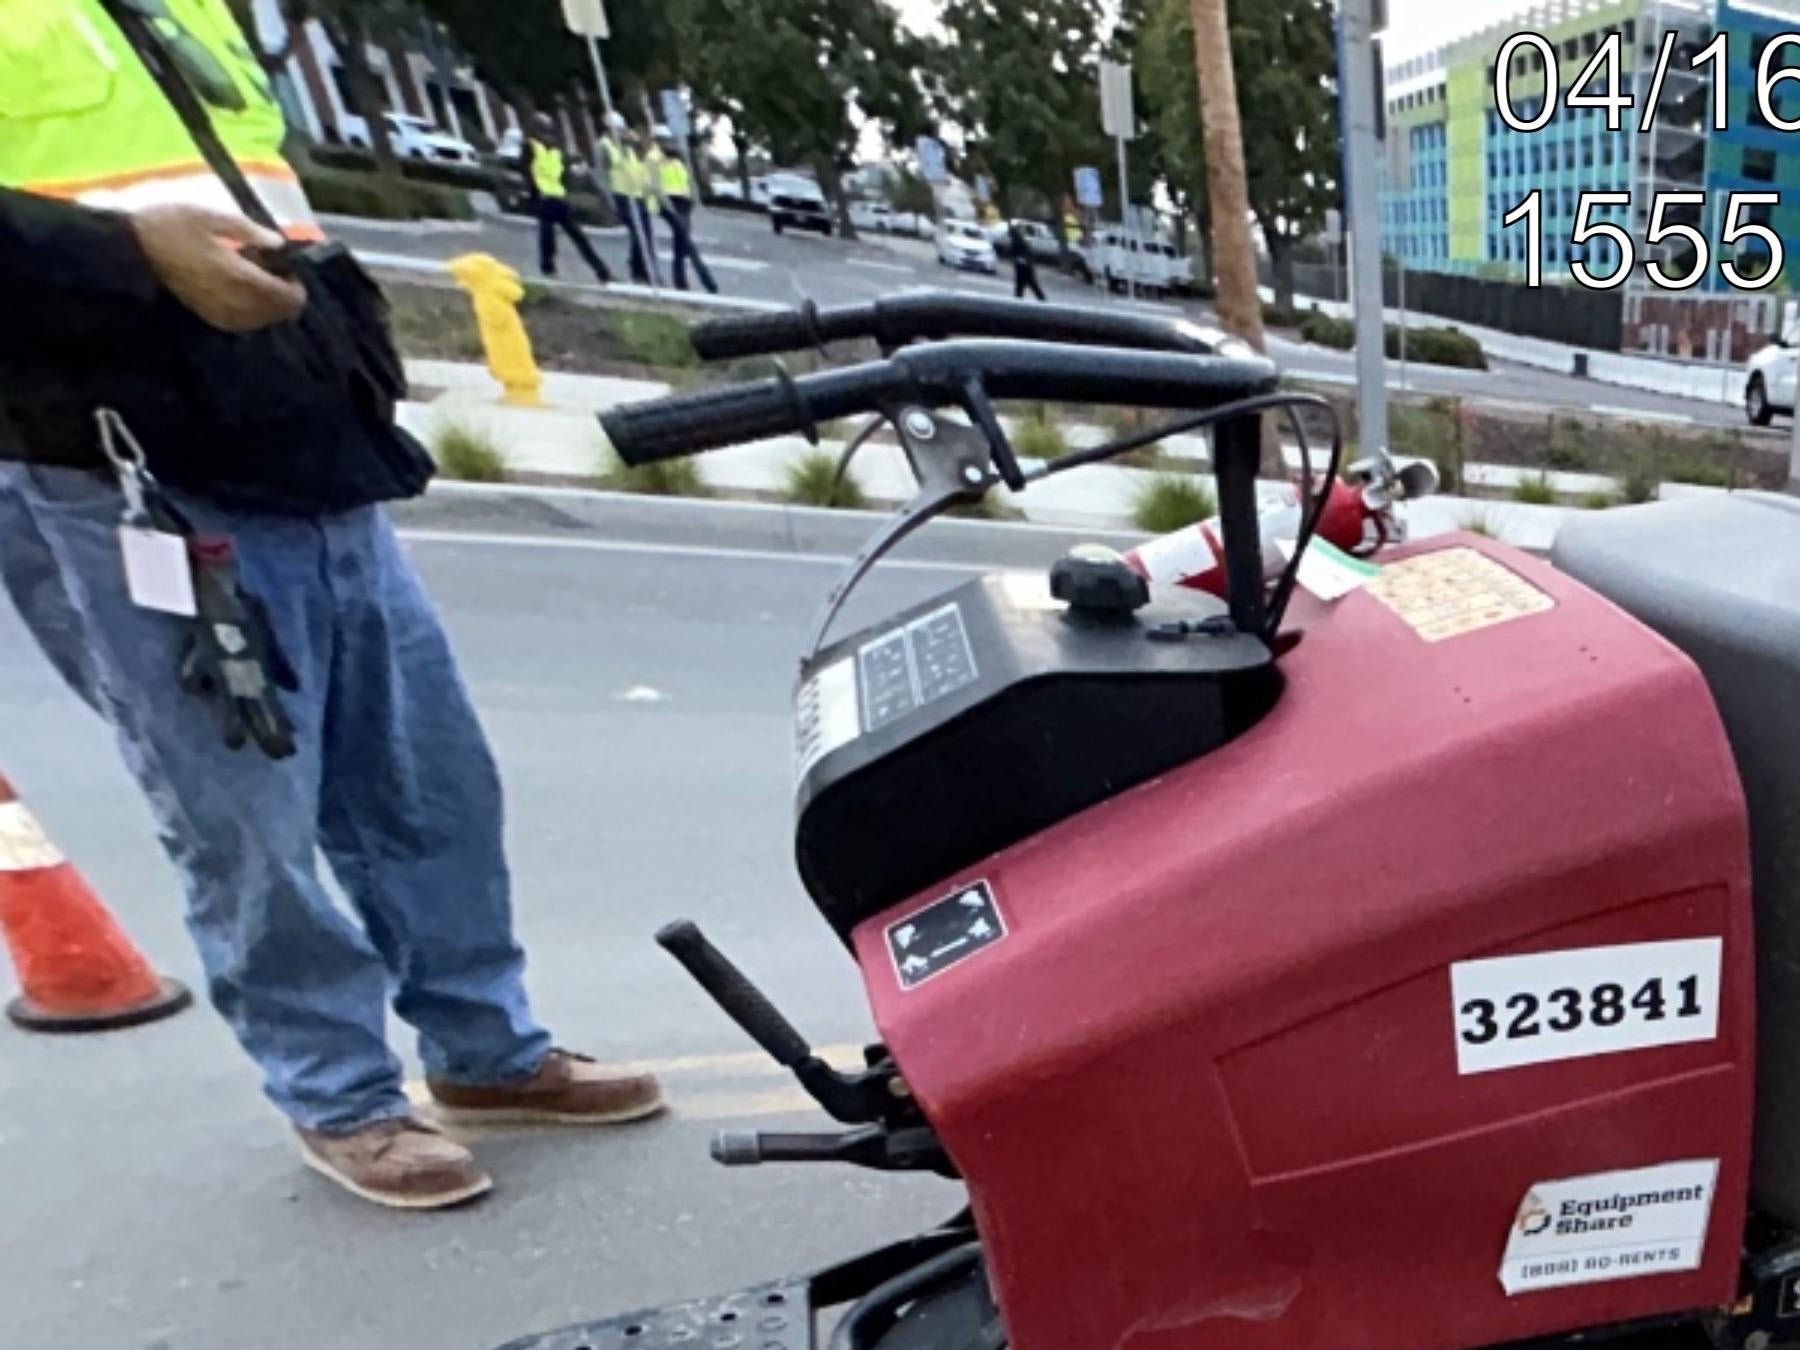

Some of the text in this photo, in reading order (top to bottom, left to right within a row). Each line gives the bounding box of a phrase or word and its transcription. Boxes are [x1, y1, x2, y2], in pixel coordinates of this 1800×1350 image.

[1460, 974, 1702, 1045] 323841
[1558, 1183, 1704, 1217] Equipment
[1555, 1213, 1634, 1237] Share
